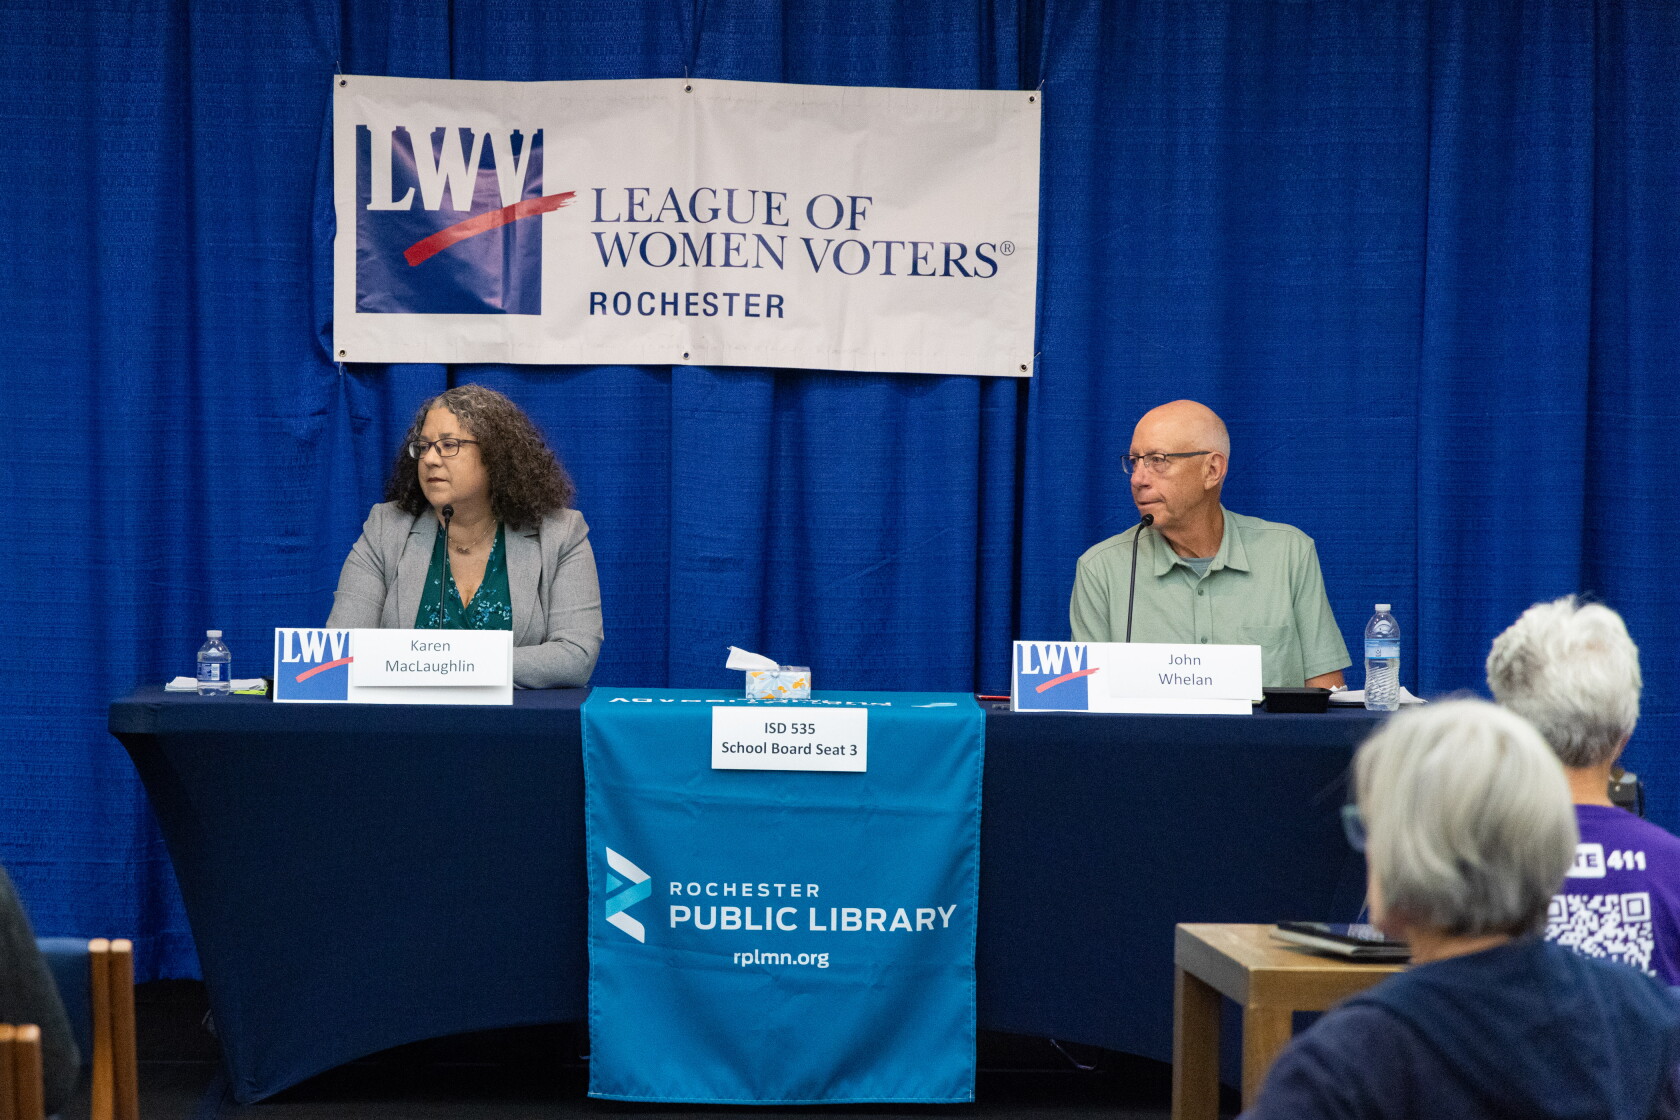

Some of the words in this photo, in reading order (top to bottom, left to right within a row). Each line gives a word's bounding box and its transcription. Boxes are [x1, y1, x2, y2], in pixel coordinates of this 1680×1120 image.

[367, 125, 541, 212] LWV
[591, 187, 790, 228] LEAGUE
[805, 193, 873, 231] OF
[591, 231, 788, 271] WOMEN
[589, 291, 785, 319] ROCHESTER
[281, 630, 350, 663] LWV
[410, 639, 451, 652] Karen
[385, 660, 475, 674] MacLaughlin
[1021, 644, 1086, 675] LWV
[1168, 653, 1201, 667] John
[1158, 672, 1213, 686] Whelan
[764, 722, 786, 735] ISD
[790, 722, 816, 736] 535
[721, 741, 767, 755] School
[771, 741, 812, 756] Board
[816, 743, 847, 756] Seat
[850, 743, 858, 757] 3
[1573, 852, 1598, 868] TE
[1607, 849, 1647, 871] 411
[669, 881, 820, 898] ROCHESTER
[669, 904, 798, 931] PUBLIC
[809, 904, 957, 932] LIBRARY
[733, 948, 830, 969] rplmn.org
